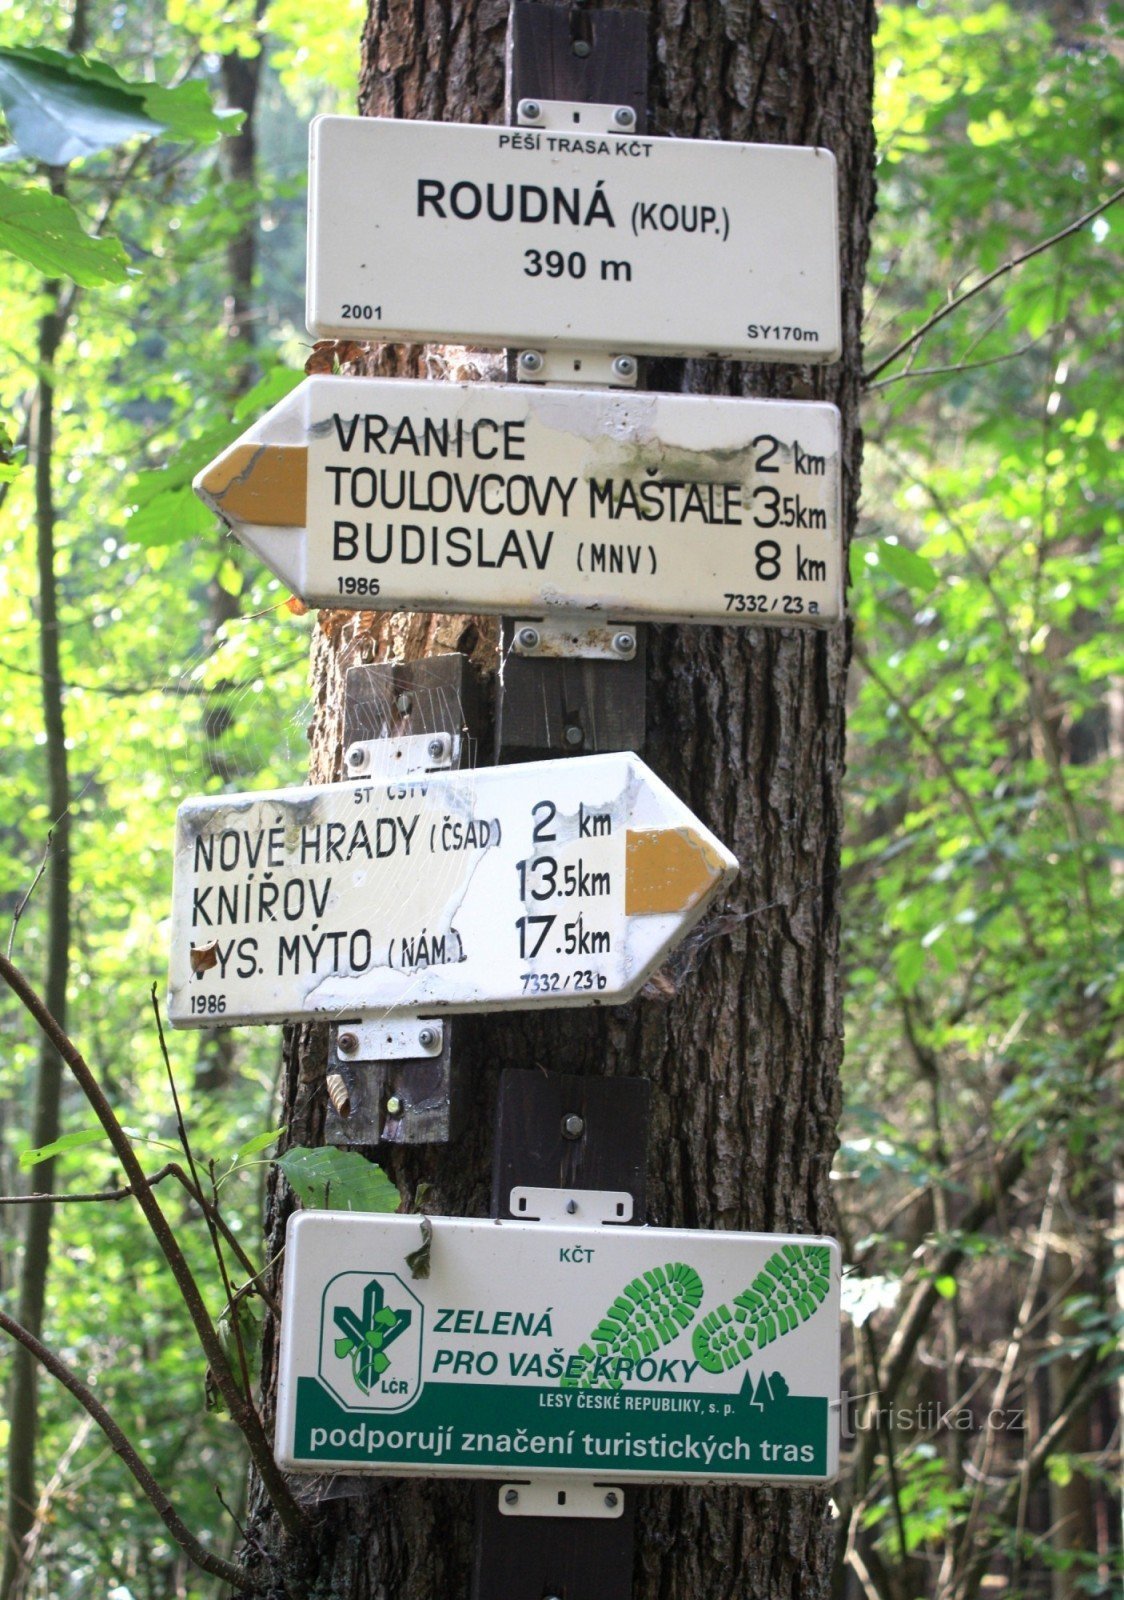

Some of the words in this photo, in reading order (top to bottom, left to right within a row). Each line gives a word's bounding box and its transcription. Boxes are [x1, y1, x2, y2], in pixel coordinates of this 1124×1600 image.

[499, 132, 541, 150] PĚŠÍ
[547, 137, 611, 155] TRASA
[615, 140, 653, 157] KČT
[417, 178, 616, 228] ROUDNÁ
[630, 202, 730, 242] (KOUP.)
[523, 248, 587, 279] 390
[600, 258, 632, 282] m
[341, 304, 383, 320] 2001
[746, 324, 819, 342] SY170m
[333, 412, 526, 461] VRANICE
[751, 434, 780, 473] 2
[794, 440, 826, 476] km
[325, 465, 578, 517] TOULOVCOVY
[589, 467, 743, 525] MAŠTALE
[333, 520, 554, 570] BUDISLAV
[754, 539, 782, 581] 8
[796, 544, 827, 582] km
[338, 576, 380, 595] 1986
[353, 786, 374, 804] ST
[193, 816, 285, 873] NOVÉ
[301, 814, 420, 865] HRADY
[430, 815, 502, 853] (ČSAD)
[531, 800, 557, 843] 2
[579, 801, 612, 838] km
[192, 872, 332, 927] KNÍŘOV
[278, 923, 372, 976] MÝTO
[388, 927, 464, 968] (NÁM.)
[190, 994, 226, 1014] 1986
[559, 1245, 595, 1264] KČT
[432, 1307, 554, 1338] ZELENÁ
[432, 1349, 499, 1376] PRO
[508, 1347, 585, 1380] VAŠE
[593, 1355, 700, 1384] KROKY
[381, 1376, 409, 1395] LČR
[539, 1393, 572, 1408] LESY
[577, 1391, 621, 1410] ČESKÉ
[624, 1395, 705, 1415] REPUBLIKY,
[708, 1402, 720, 1414] s.
[724, 1403, 735, 1417] p.
[309, 1422, 452, 1457] podporují
[461, 1428, 575, 1455] značení
[582, 1432, 751, 1465] turistických
[760, 1439, 815, 1463] tras
